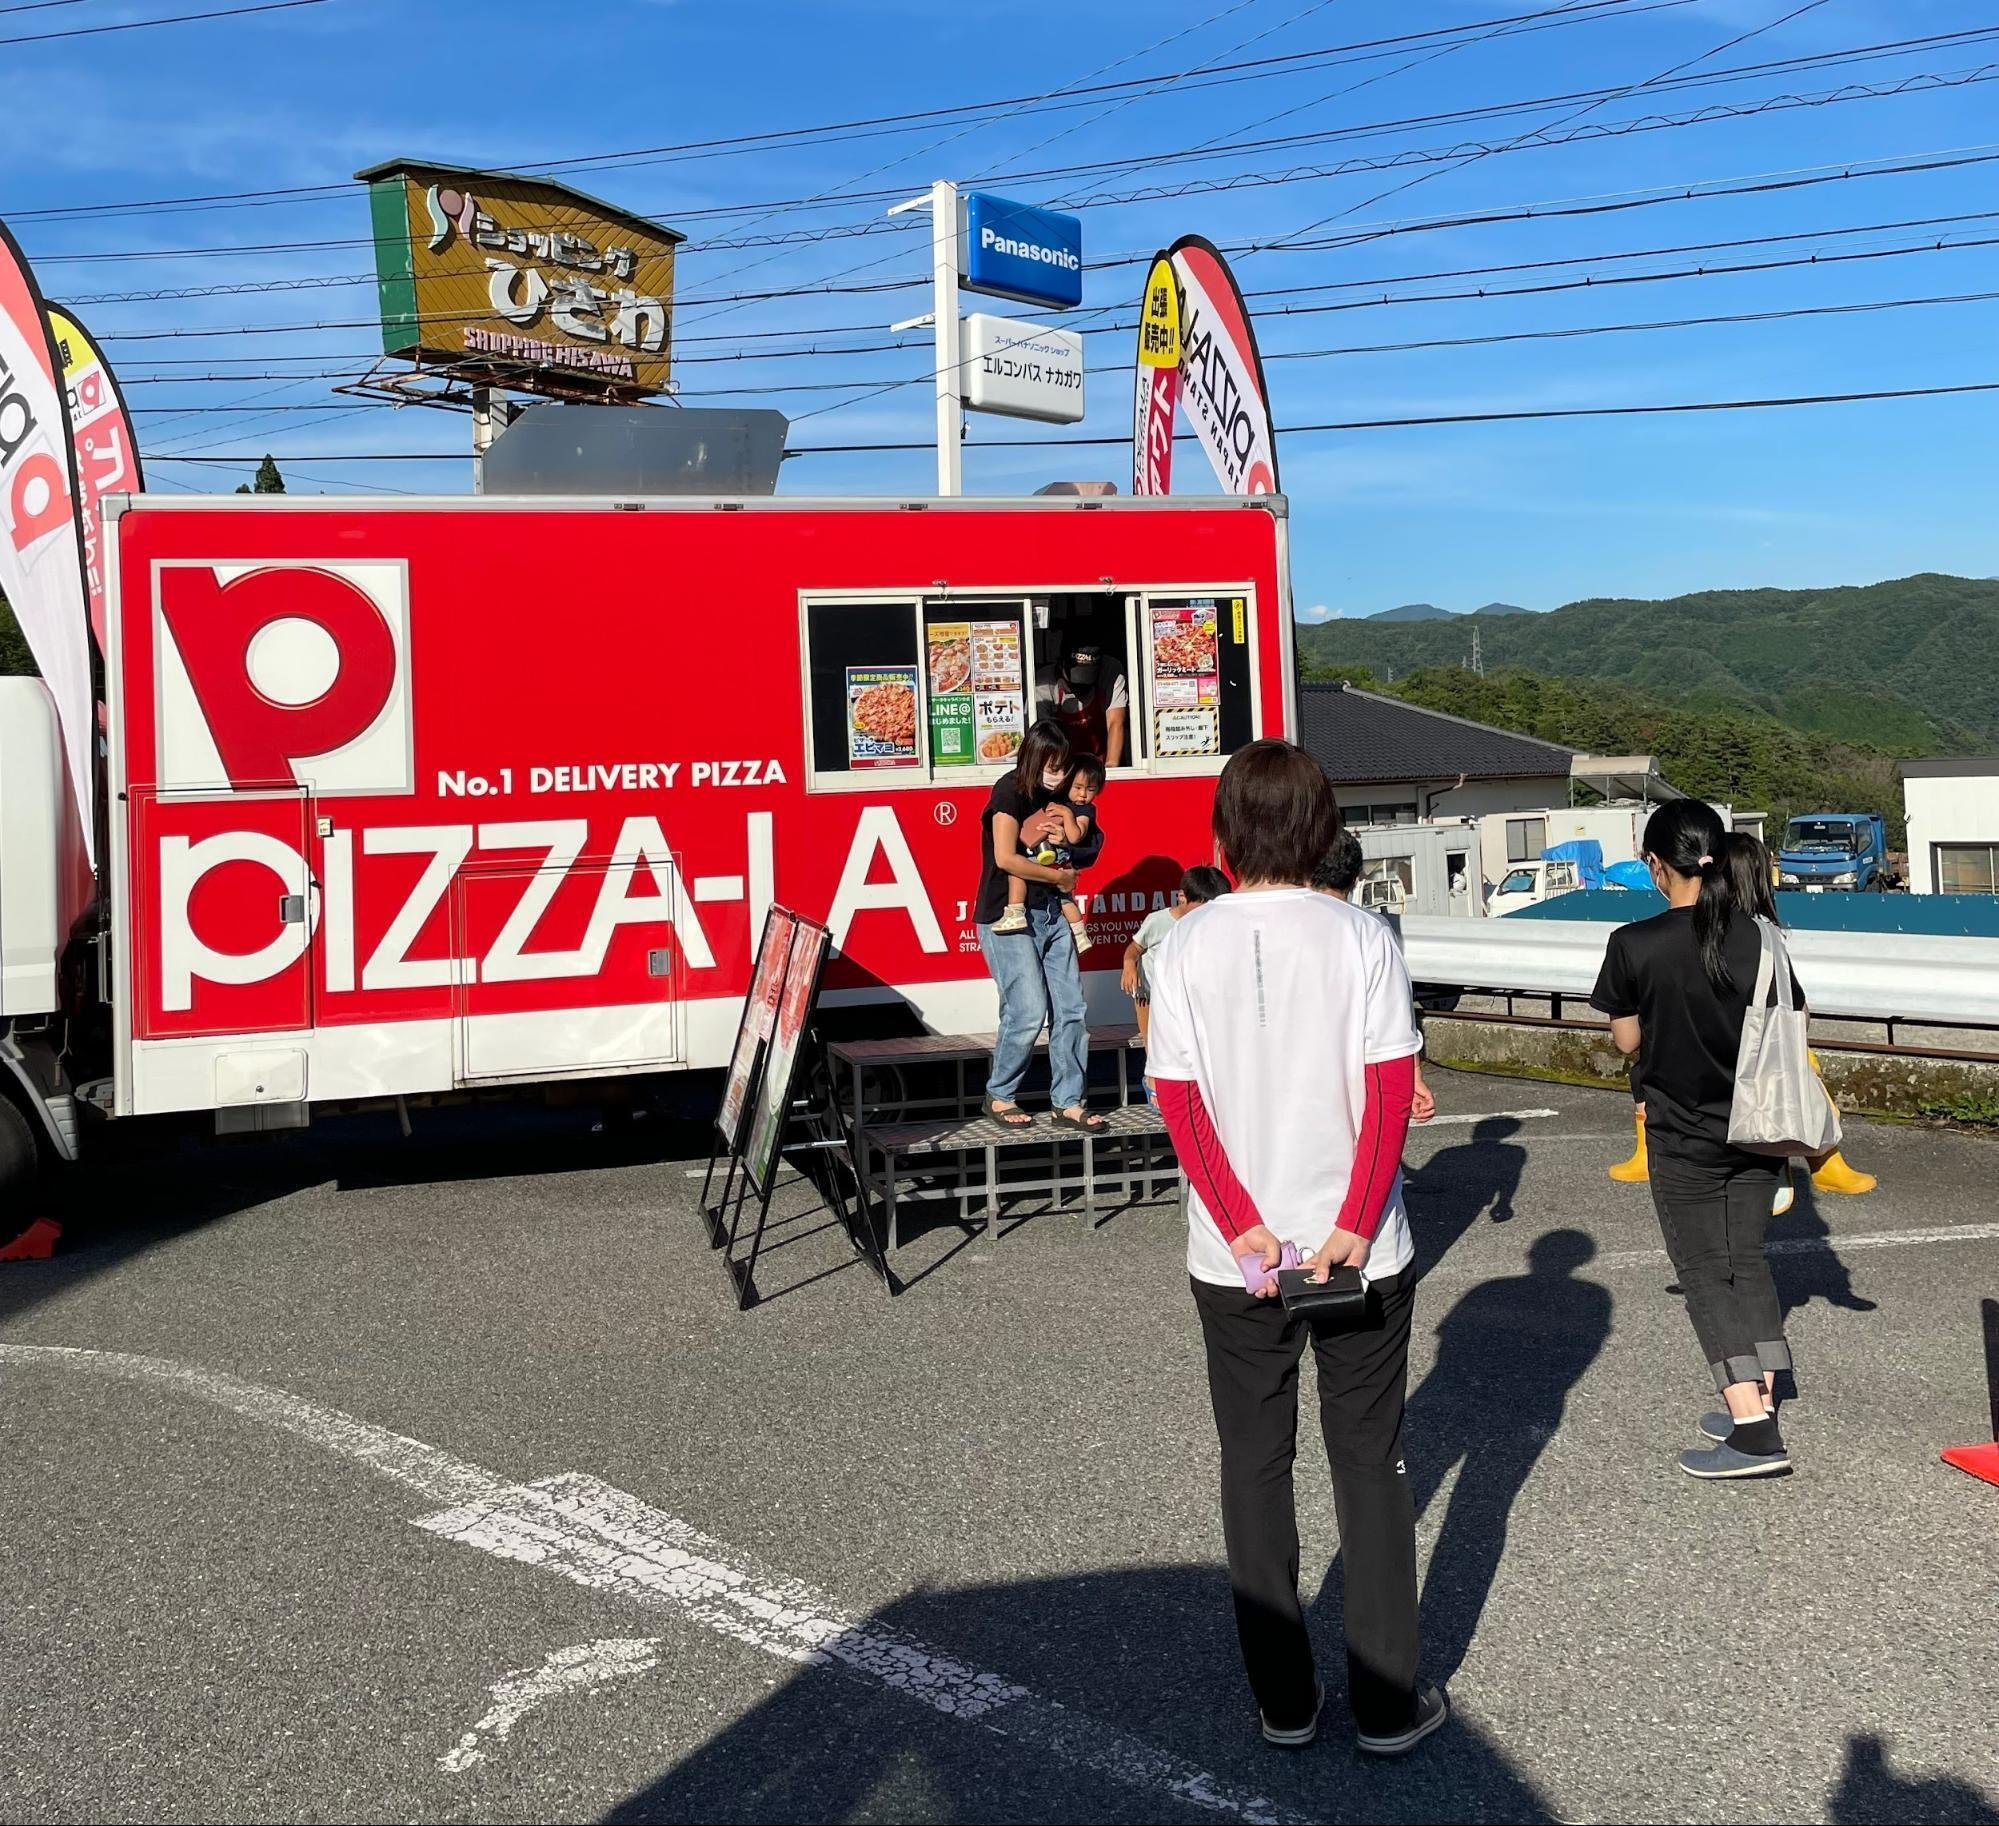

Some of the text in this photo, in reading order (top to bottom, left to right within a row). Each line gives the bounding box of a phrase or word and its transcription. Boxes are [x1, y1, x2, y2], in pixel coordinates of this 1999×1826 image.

[476, 211, 632, 277] ショッピング
[981, 227, 1079, 271] Panasonic
[484, 257, 666, 352] ひさわ
[463, 327, 634, 379] SHOPPING HISAWA
[1045, 366, 1082, 389] ナカガワ
[979, 700, 1020, 716] ポテト
[438, 759, 787, 797] No.1 DELIVERY PIZZA
[960, 929, 976, 940] ALL
[1102, 922, 1121, 932] YOU
[1114, 933, 1128, 944] TO
